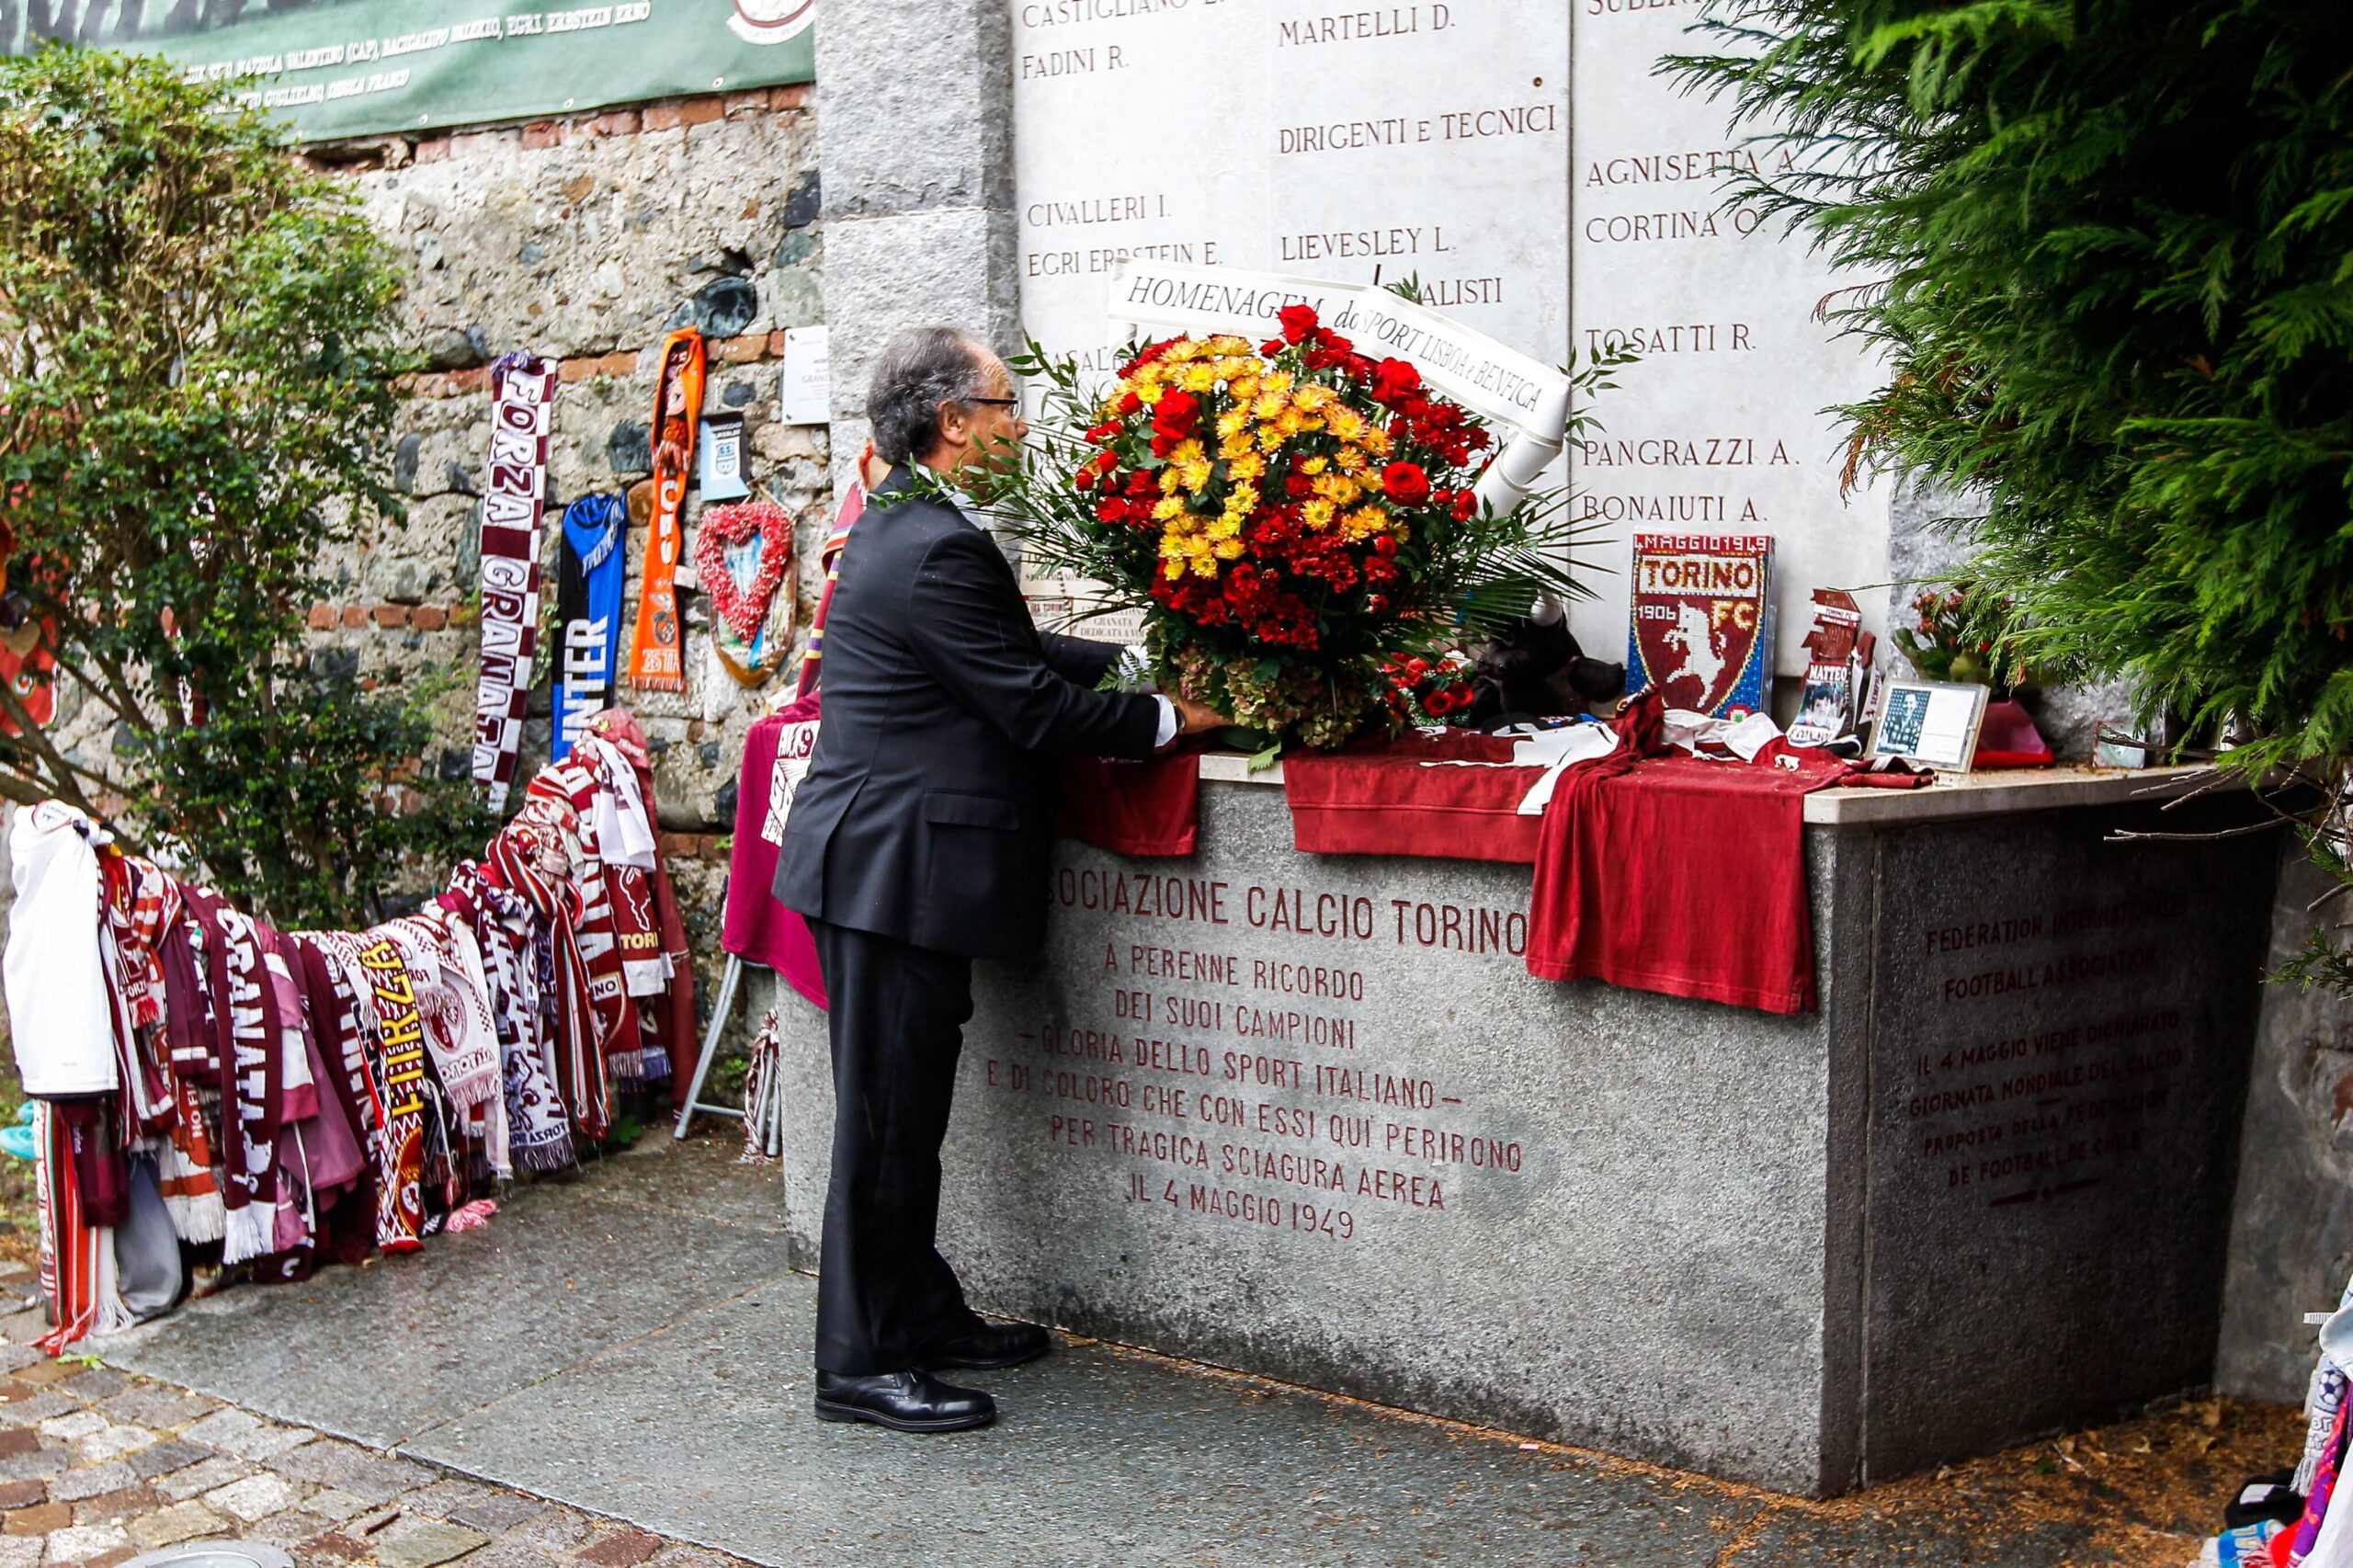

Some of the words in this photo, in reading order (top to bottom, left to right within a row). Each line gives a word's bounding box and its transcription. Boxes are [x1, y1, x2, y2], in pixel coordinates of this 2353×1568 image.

[1278, 7, 1421, 48] MARTELLI
[1431, 4, 1457, 31] D.
[1021, 49, 1095, 80] FADINI
[1108, 45, 1130, 70] R.
[1279, 117, 1407, 154] DIRIGENTI
[1439, 104, 1558, 141] TECNICI
[1586, 150, 1759, 187] AGNISETTA
[1028, 196, 1146, 227] CIVALLERI
[1158, 194, 1172, 218] I.
[1586, 210, 1719, 244] CORTINA
[1734, 209, 1768, 236] O.
[1028, 252, 1080, 277] EGRI
[1204, 242, 1223, 266] E.
[1281, 227, 1422, 262] LIEVESLEY
[1435, 227, 1457, 254] L.
[1418, 278, 1503, 307] ALISTI
[1586, 325, 1716, 354] TOSATTI
[1733, 324, 1756, 351] R.
[1358, 310, 1425, 353] SPORT
[1419, 335, 1470, 379] LISBOA
[1473, 361, 1543, 412] BENFICA
[487, 369, 545, 524] FORZA
[1584, 438, 1755, 467] PANGRAZZI
[1768, 438, 1801, 465] A.
[1584, 495, 1725, 523] BONAIUTI
[1740, 495, 1768, 523] A.
[1644, 560, 1754, 590] TORINO
[1638, 605, 1677, 620] 1906
[1711, 600, 1754, 631] FC
[473, 557, 527, 772] GRANATA
[562, 615, 608, 743] INTER
[1810, 665, 1847, 681] MATTEO
[1246, 885, 1374, 941] CALCIO
[1392, 899, 1528, 958] TORINO
[1927, 915, 2042, 956] FEDERATION
[1104, 943, 1119, 971] A
[1131, 945, 1239, 986] PERENNE
[1254, 961, 1363, 1002] RICORDO
[1945, 967, 2038, 1002] FOOTBALL
[1115, 990, 1153, 1023] DEI
[1166, 996, 1222, 1031] SUOI
[1236, 1006, 1355, 1050] CAMPIONI
[1042, 1024, 1122, 1063] GLORIA
[1136, 1039, 1211, 1077] DELLO
[1223, 1051, 1302, 1089] SPORT
[1315, 1064, 1434, 1110] ITALIANO
[1917, 1056, 1930, 1077] IL
[1940, 1051, 1953, 1072] 4
[1961, 1038, 2027, 1071] MAGGIO
[2034, 1027, 2080, 1056] VIENE
[1909, 1083, 1995, 1119] GIORNATA
[2002, 1064, 2084, 1100] MONDIALE
[2089, 1059, 2119, 1082] DEL
[987, 1059, 1000, 1087] E
[1012, 1063, 1031, 1091] DI
[1041, 1069, 1131, 1109] COLORO
[1142, 1085, 1188, 1119] CHE
[1199, 1095, 1245, 1128] CON
[1257, 1104, 1315, 1140] ESSI
[1329, 1113, 1372, 1150] QUI
[1385, 1123, 1522, 1174] PERIRONO
[1924, 1126, 2002, 1157] PROPOSTA
[2011, 1113, 2058, 1137] DELLA
[1051, 1113, 1096, 1148] PER
[1108, 1123, 1210, 1171] TRAGICA
[1222, 1144, 1347, 1195] SCIAGURA
[1357, 1167, 1446, 1210] AEREA
[1949, 1165, 1971, 1187] DE
[1980, 1147, 2067, 1181] FOOTBALL
[1130, 1173, 1152, 1203] IL
[1163, 1180, 1179, 1209] 4
[1189, 1183, 1281, 1228] MAGGIO
[1291, 1203, 1355, 1240] 1949
